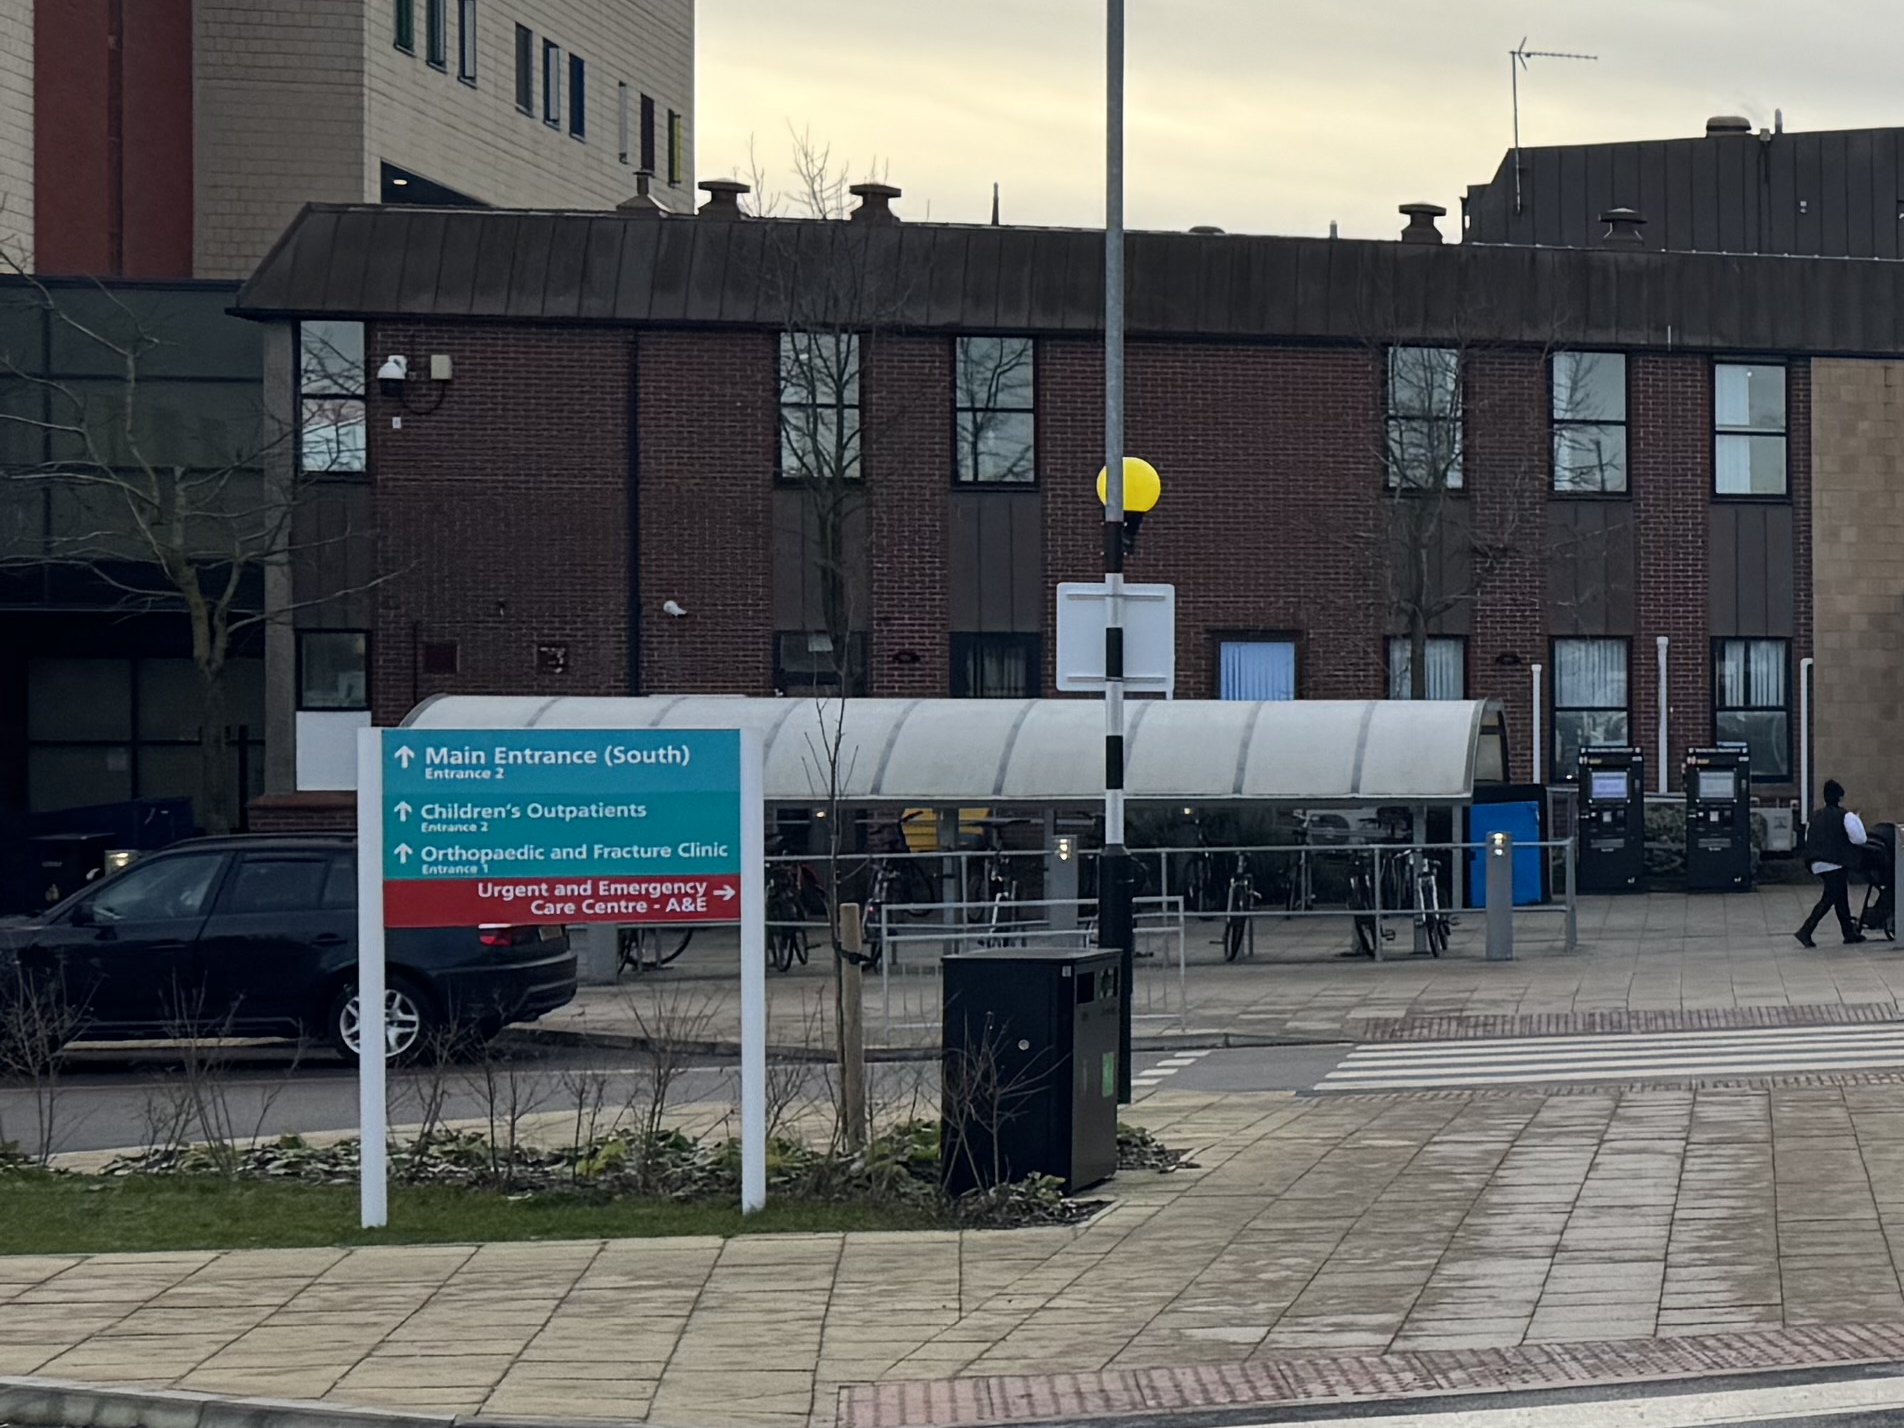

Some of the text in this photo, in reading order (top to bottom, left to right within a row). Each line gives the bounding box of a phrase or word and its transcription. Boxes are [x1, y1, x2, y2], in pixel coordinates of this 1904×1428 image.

[426, 745, 691, 766] Main Entrance (South)
[425, 768, 504, 779] Entrance 2
[421, 802, 647, 822] Children's Outpatients
[421, 822, 489, 833] Entrance 2
[421, 842, 728, 864] Orthopaedic and Fracture Clinic
[422, 864, 477, 874] Entrance
[477, 881, 707, 901] Urgent and Emergency
[530, 899, 575, 915] Care
[582, 899, 648, 914] Centre
[665, 897, 707, 912] A&E
